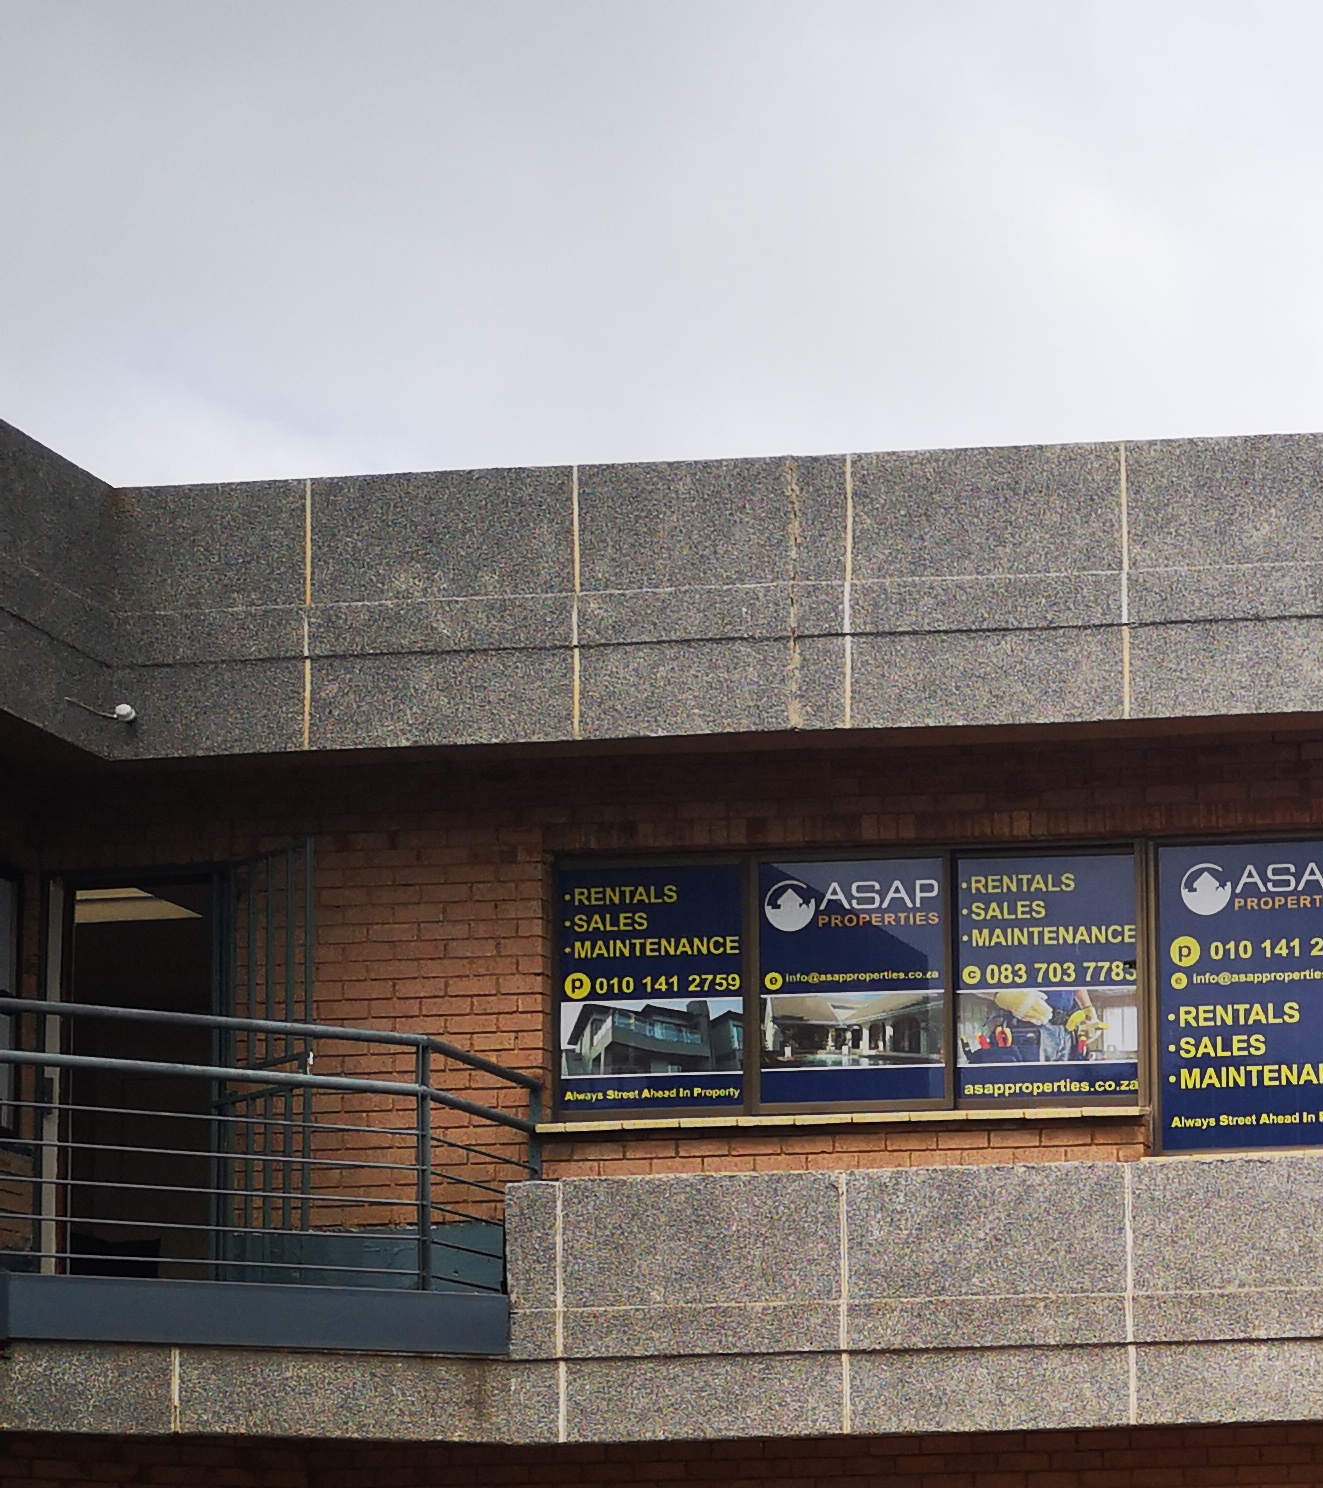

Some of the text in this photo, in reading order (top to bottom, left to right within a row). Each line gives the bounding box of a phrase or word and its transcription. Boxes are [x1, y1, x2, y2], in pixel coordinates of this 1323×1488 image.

[971, 873, 1076, 894] RENTALS
[574, 885, 678, 906] RENTALS
[819, 879, 939, 910] ASAP
[818, 912, 940, 927] PROPERTIES
[971, 900, 1046, 920] SALES
[573, 912, 648, 932] SALES
[972, 925, 1136, 947] MAINTENANCE
[574, 936, 740, 959] MAINTENANCE
[1210, 940, 1253, 960] 010
[1261, 938, 1300, 958] 141
[595, 976, 634, 994] 010
[641, 975, 679, 993] 141
[688, 973, 741, 991] 2759
[785, 970, 939, 984] info@asapproperties.co.za
[986, 963, 1027, 984] 083
[1033, 962, 1076, 983] 703
[1179, 1002, 1300, 1028] RENTALS
[1179, 1034, 1266, 1058] SALES
[564, 1087, 741, 1103] Always Street Ahead In Property
[964, 1079, 1138, 1097] asapproperties.co.za
[1171, 1116, 1216, 1129] Always
[1219, 1114, 1257, 1126] Street
[1259, 1112, 1299, 1125] Ahead
[1303, 1112, 1315, 1123] In
